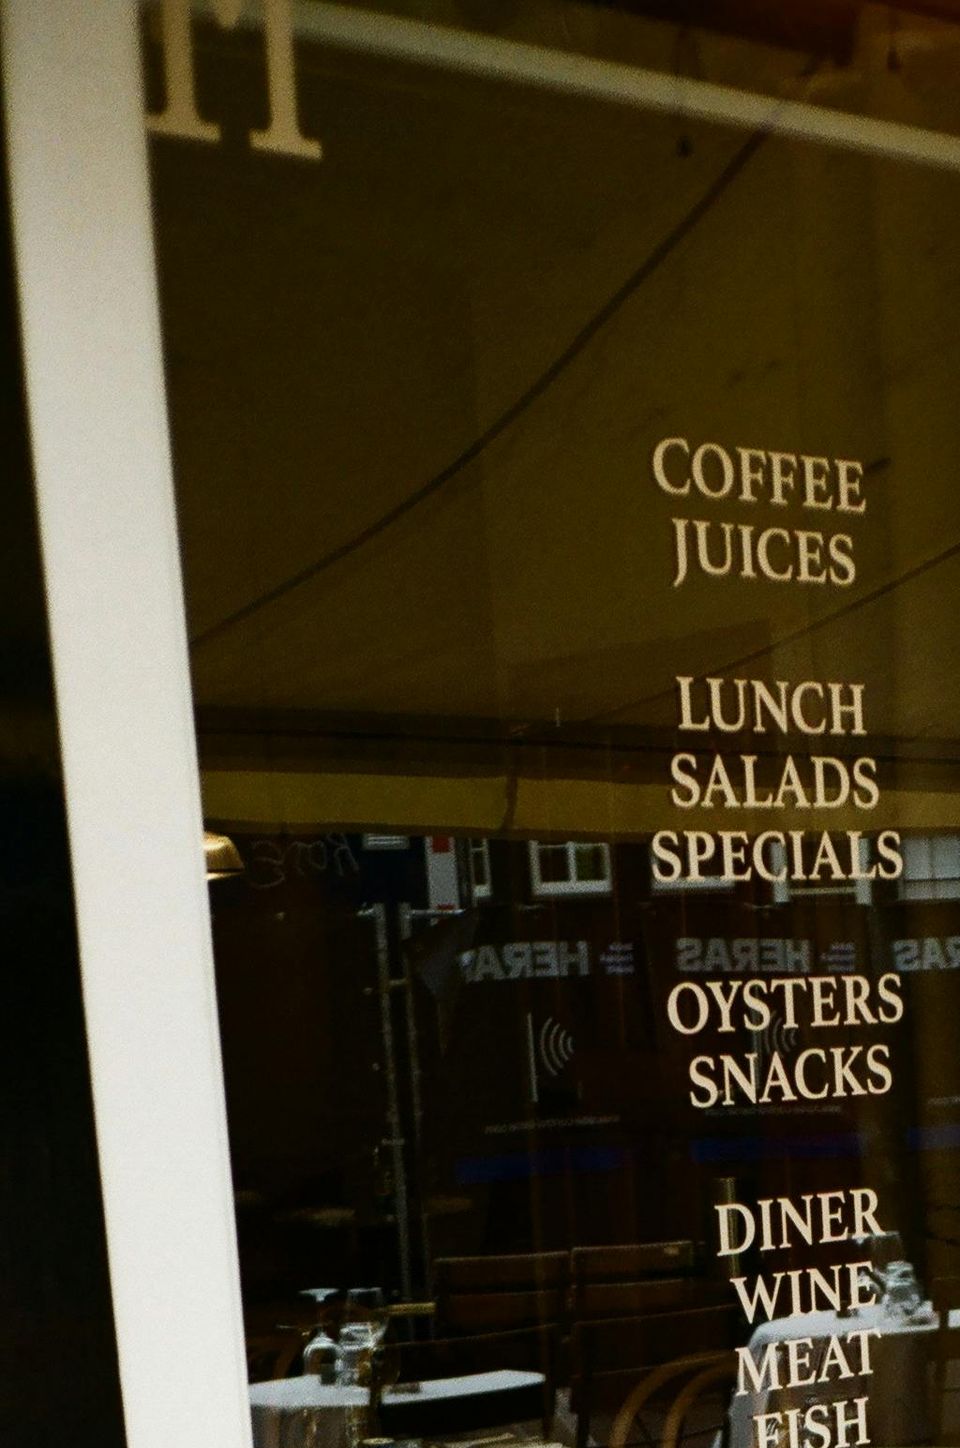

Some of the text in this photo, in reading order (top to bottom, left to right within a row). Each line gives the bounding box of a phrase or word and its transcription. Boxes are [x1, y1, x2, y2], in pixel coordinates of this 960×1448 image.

[652, 437, 867, 513] COFFEE
[672, 517, 857, 588] JUICES
[676, 676, 868, 735] LUNCH
[670, 753, 880, 809] SALADS
[651, 830, 904, 886] SPECIALS
[667, 973, 903, 1035] OYSTERS
[689, 1044, 893, 1108] SNACKS
[714, 1187, 886, 1257] DINER
[730, 1260, 877, 1324] WINE
[735, 1327, 881, 1395] MEAT
